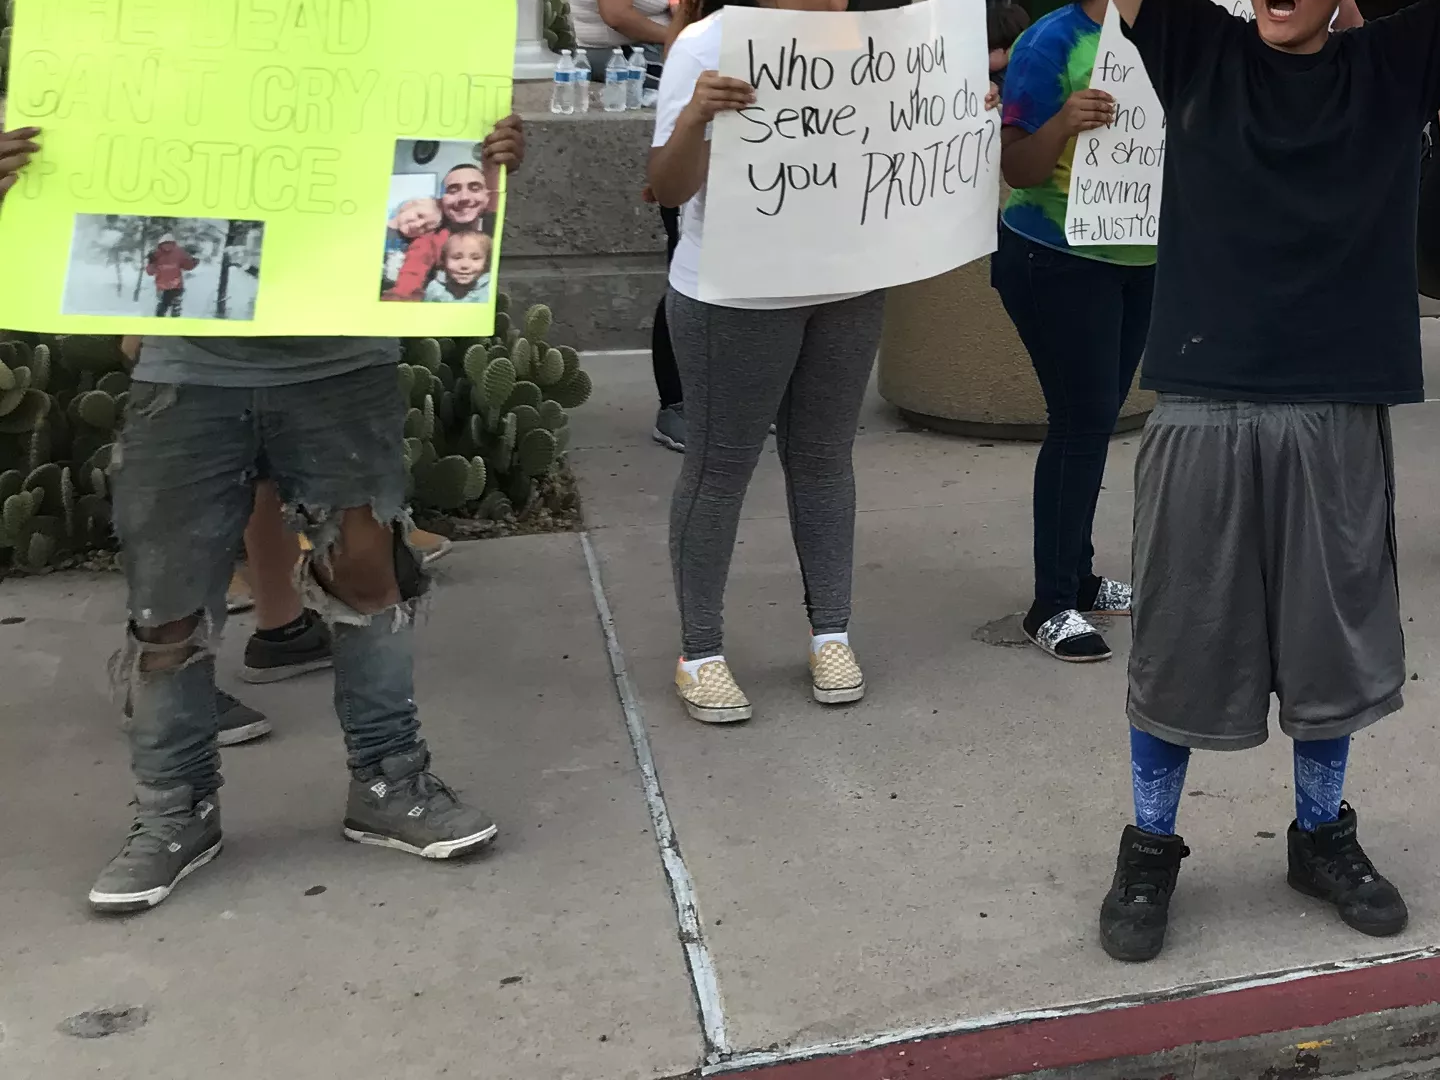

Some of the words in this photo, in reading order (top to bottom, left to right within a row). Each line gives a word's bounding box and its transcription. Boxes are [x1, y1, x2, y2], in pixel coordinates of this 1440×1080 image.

[749, 38, 834, 91] Who
[851, 36, 896, 86] do
[906, 35, 948, 89] you
[1098, 51, 1135, 83] for
[15, 48, 222, 127] CAN'T
[250, 65, 380, 133] CRY
[386, 72, 513, 137] OUT
[953, 78, 978, 121] do
[1105, 103, 1146, 133] ho
[69, 134, 357, 215] JUSTICE.
[748, 162, 837, 216] you
[861, 119, 995, 226] PROTECT?
[1085, 137, 1100, 167] &
[1111, 138, 1166, 168] shot
[1075, 176, 1152, 222] leaving
